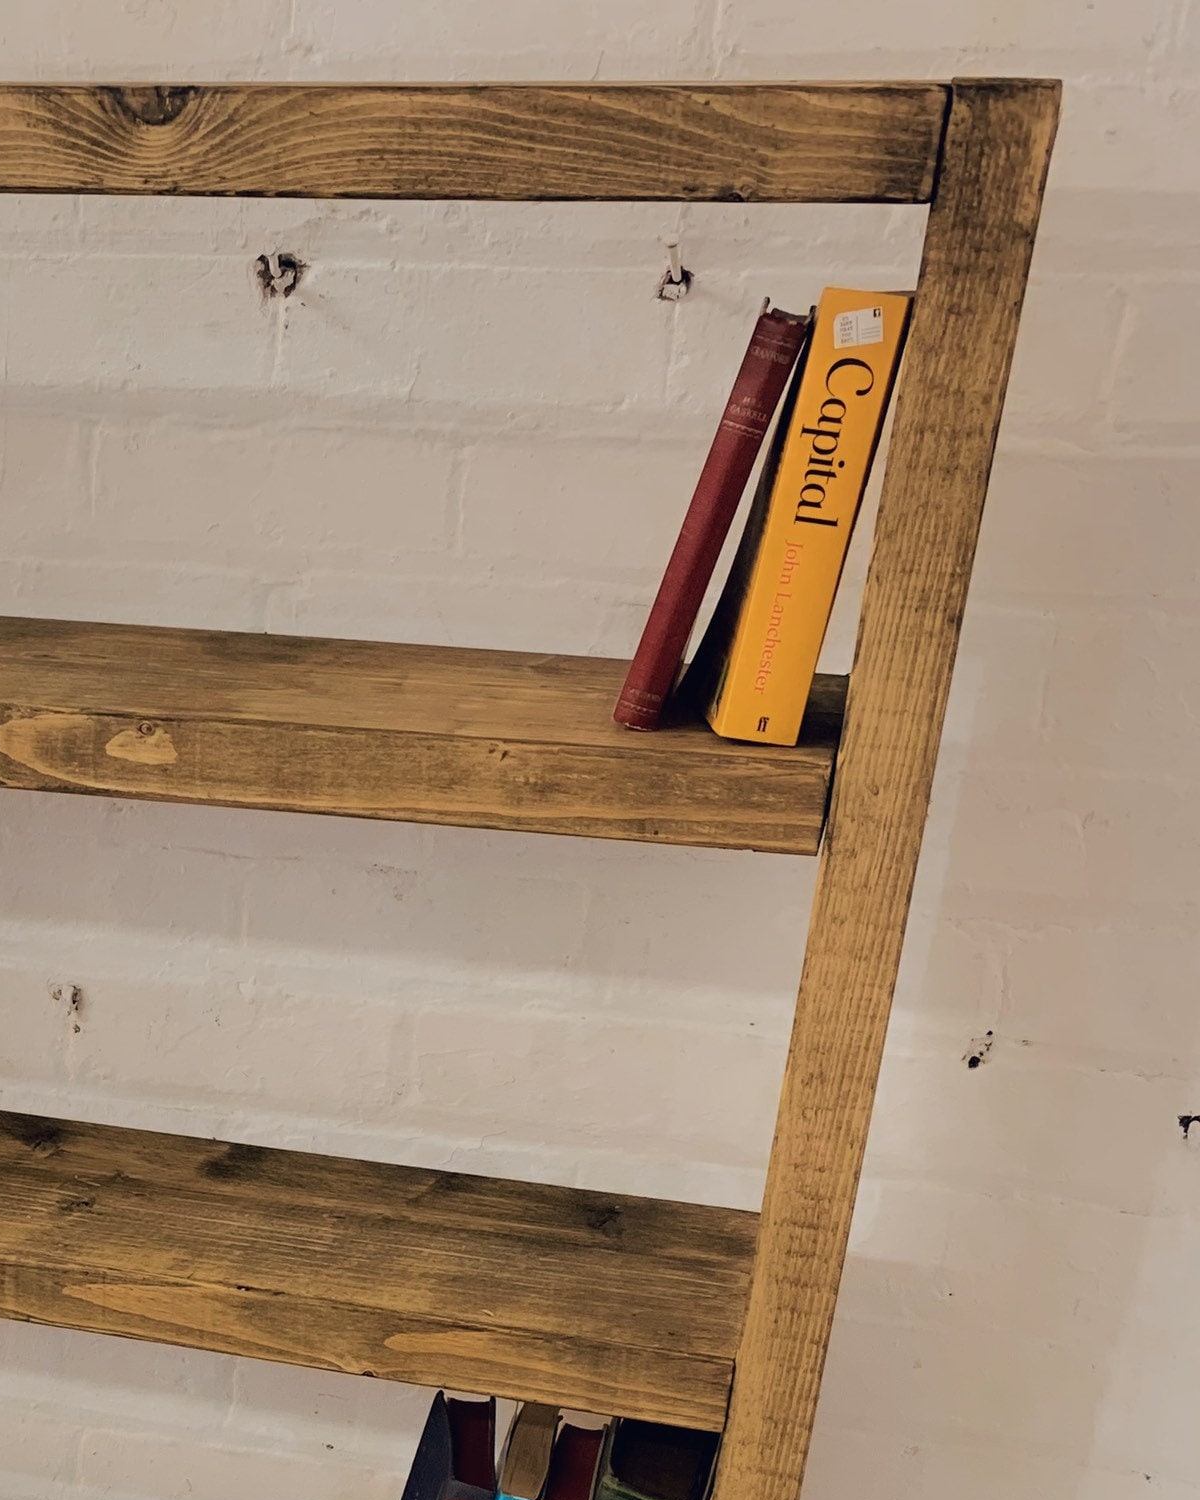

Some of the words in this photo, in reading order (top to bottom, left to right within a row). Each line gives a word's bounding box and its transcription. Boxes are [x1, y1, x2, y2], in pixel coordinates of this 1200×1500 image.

[794, 358, 875, 527] Capital
[779, 539, 804, 585] John
[754, 592, 792, 696] Lanchester
